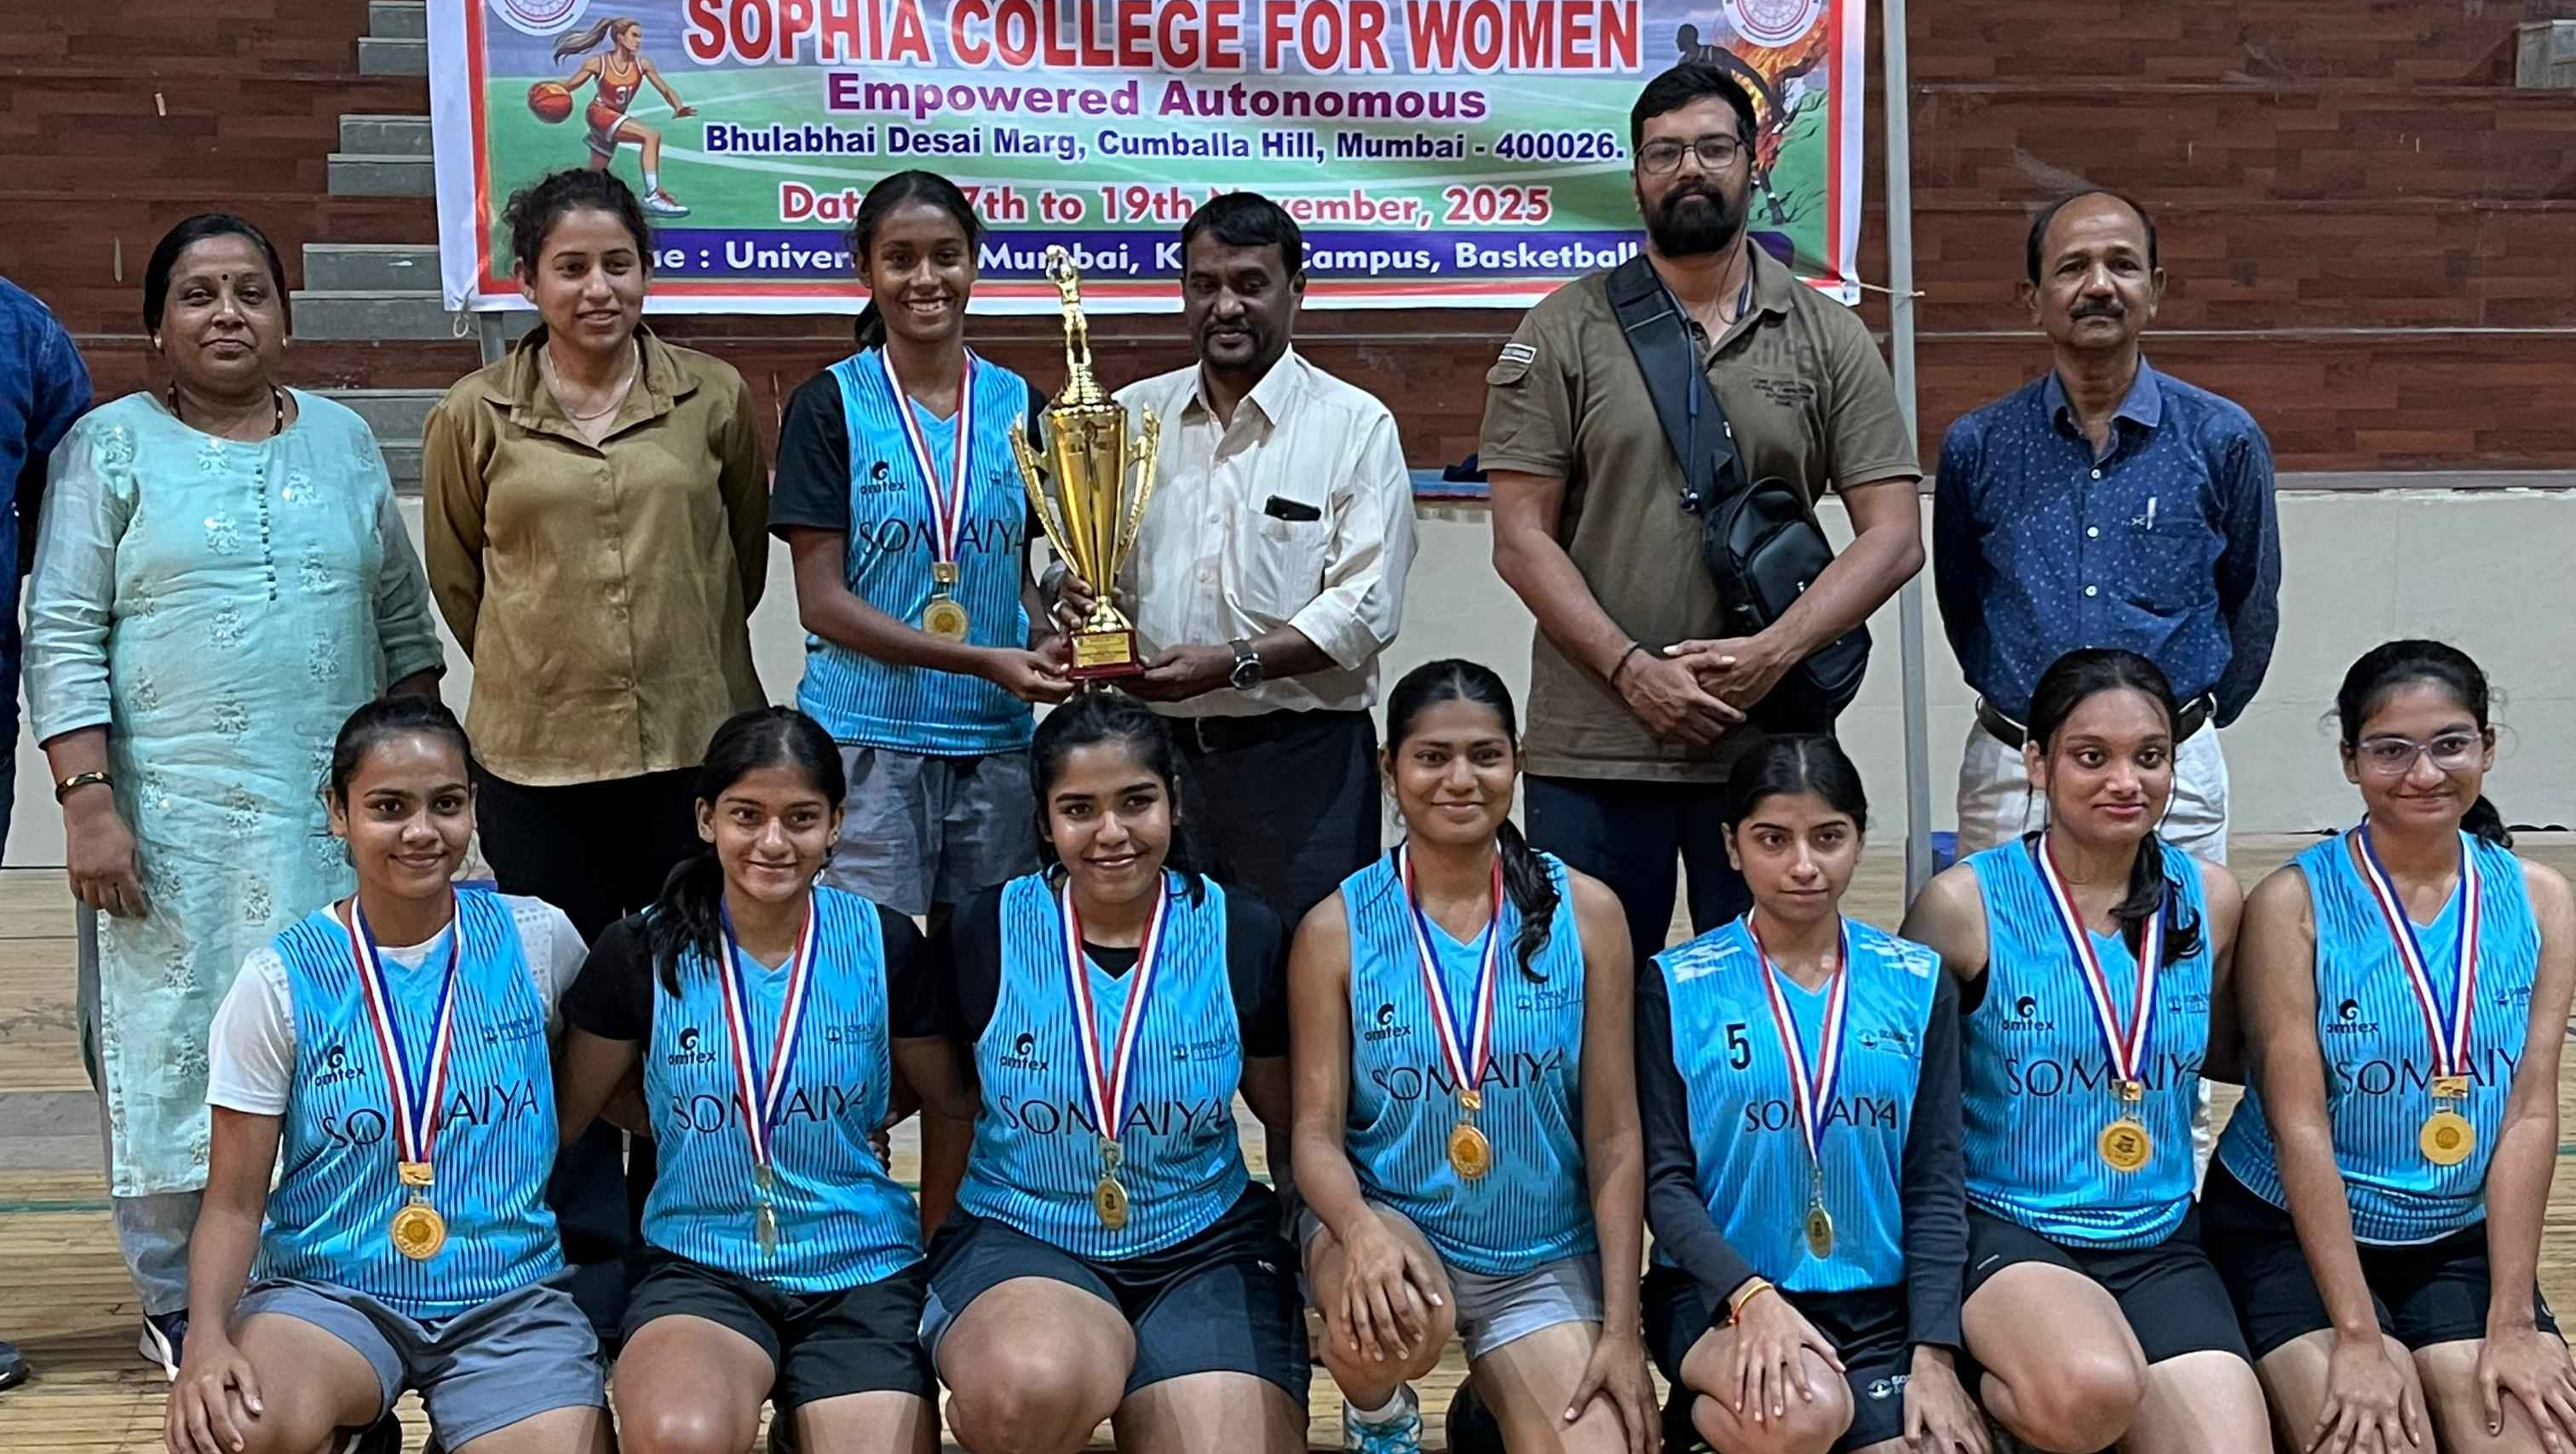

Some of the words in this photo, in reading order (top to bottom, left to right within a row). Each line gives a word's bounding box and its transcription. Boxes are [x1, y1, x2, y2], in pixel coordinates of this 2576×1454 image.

[688, 0, 932, 62] SOPHIA
[951, 0, 1240, 68] COLLEGE
[1264, 0, 1389, 70] FOR
[1407, 0, 1637, 69] WOMEN
[828, 73, 1139, 119] Empowered
[1158, 79, 1486, 118] Autonomous
[706, 125, 875, 154] Bhulabhai
[888, 127, 980, 154] Desai
[993, 129, 1086, 161] Marg,
[1098, 129, 1250, 157] Cumballa
[1262, 132, 1325, 163] Hill,
[1337, 132, 1464, 158] Mumbai
[1495, 133, 1624, 159] 400026.
[782, 186, 859, 220] Dat
[960, 187, 1025, 220] 7th
[1040, 193, 1083, 220] to
[1102, 187, 1193, 220] 19th
[1210, 187, 1429, 227] ember,
[1446, 187, 1550, 221] 2025
[725, 241, 855, 269] Univer
[977, 242, 1140, 274] Mubai,
[1455, 241, 1637, 268] Basketball
[1364, 1024, 1412, 1042] omtex
[2002, 1019, 2055, 1032] omtex
[667, 1049, 716, 1066] omtex
[999, 1055, 1049, 1072] omtex
[1726, 1023, 1751, 1071] 5
[314, 1066, 366, 1087] omtex
[2336, 1047, 2524, 1095] SOMAIY
[322, 1078, 539, 1149] SOAIYA
[1745, 1096, 1897, 1133] SOAIYA
